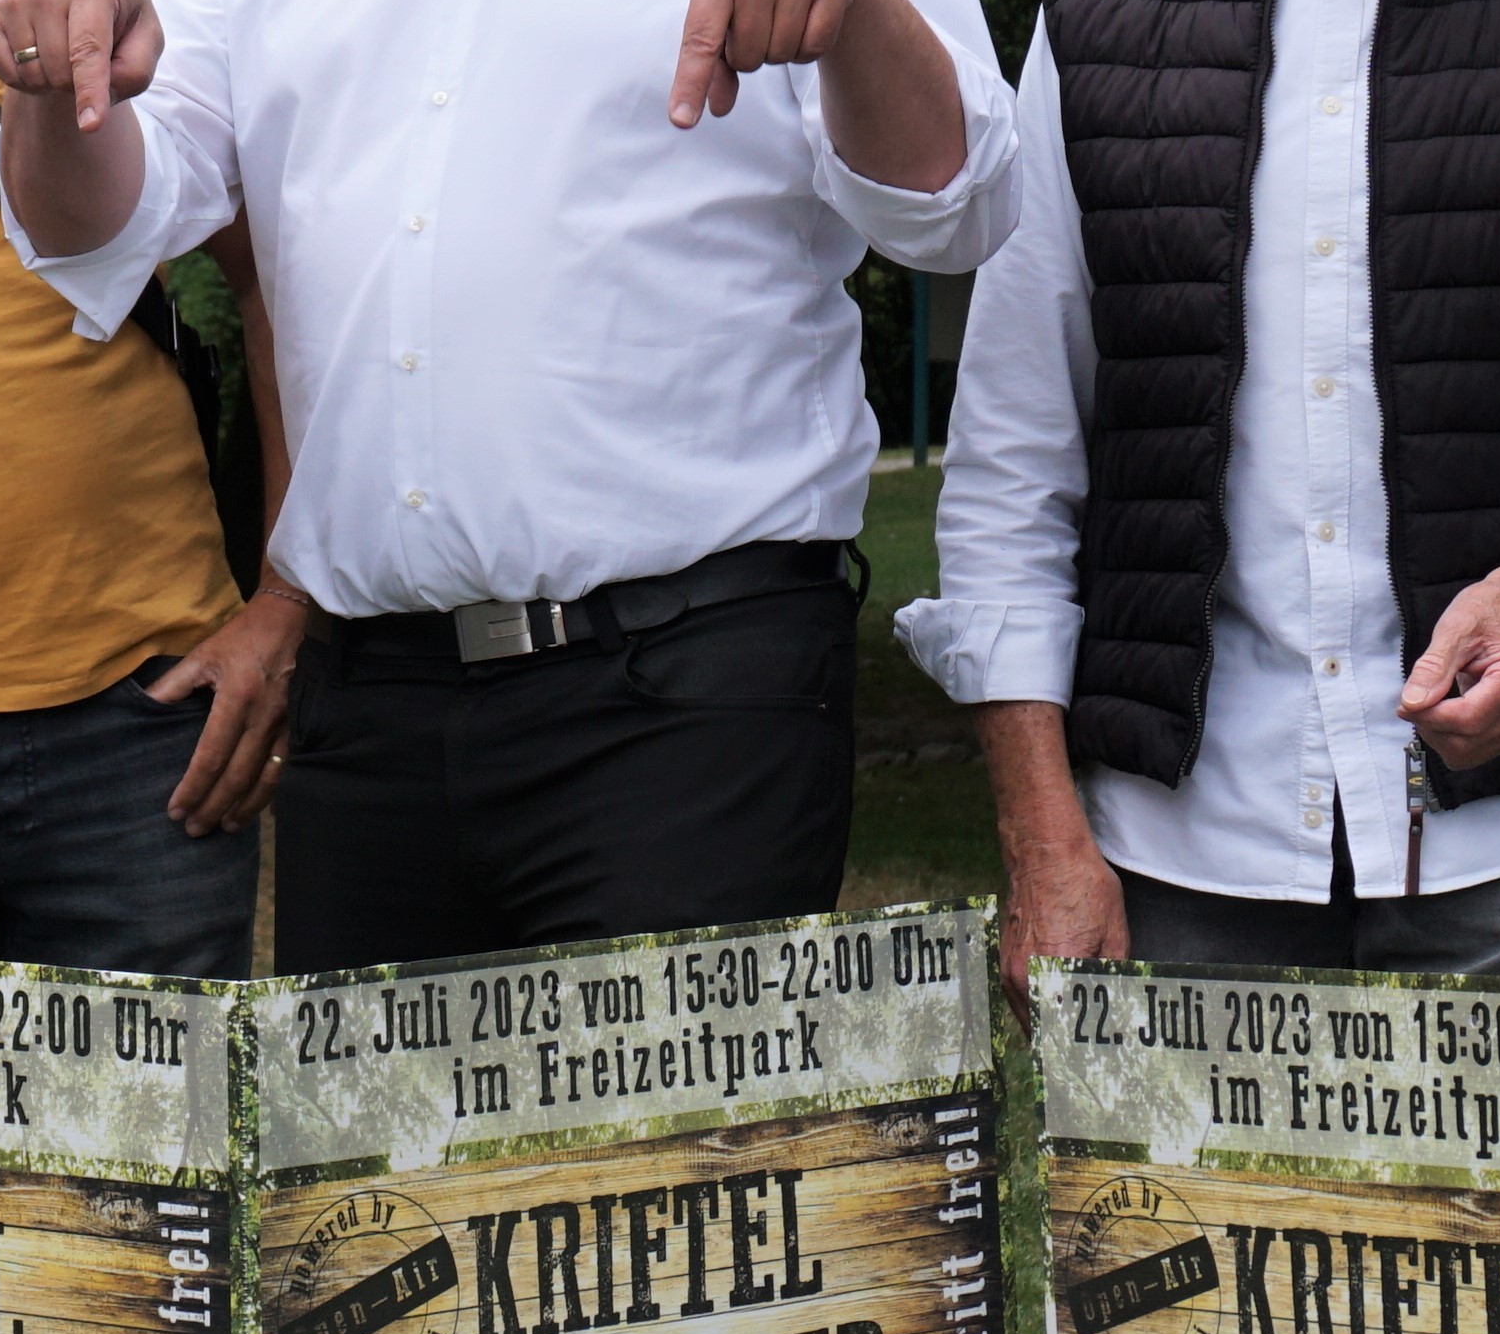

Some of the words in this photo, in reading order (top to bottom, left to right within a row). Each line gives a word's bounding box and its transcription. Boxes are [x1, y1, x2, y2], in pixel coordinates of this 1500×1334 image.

[113, 996, 188, 1067] Uhr
[453, 1056, 510, 1118] im
[537, 1008, 822, 1107] Freizeitpark
[1072, 983, 1123, 1045] 22.
[1138, 983, 1207, 1051] Juli
[1222, 989, 1314, 1057] 2023
[1327, 1008, 1394, 1061] von
[1210, 1063, 1263, 1127] im
[935, 1106, 982, 1225] frei!
[158, 1200, 211, 1328] frei!
